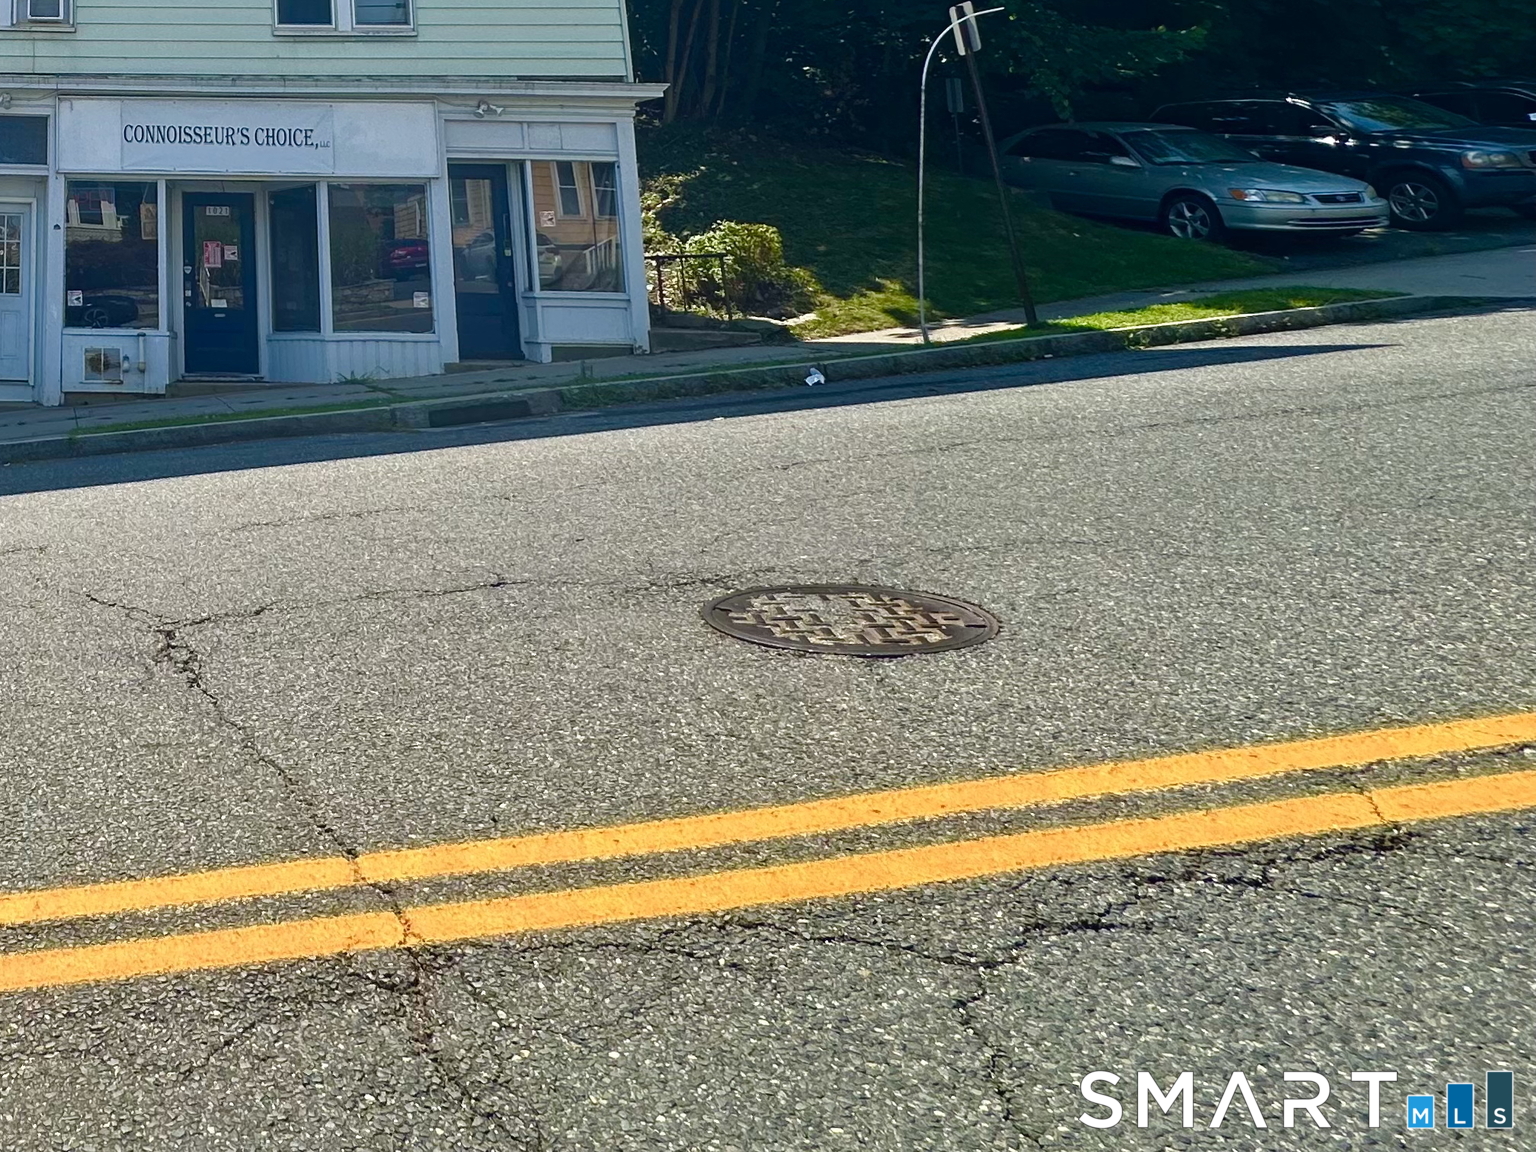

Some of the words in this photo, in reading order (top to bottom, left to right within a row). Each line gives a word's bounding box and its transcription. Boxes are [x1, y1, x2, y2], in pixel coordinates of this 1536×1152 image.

[123, 124, 250, 146] CONNOISSEUR'S
[319, 140, 331, 148] LLC
[207, 207, 229, 215] 1021
